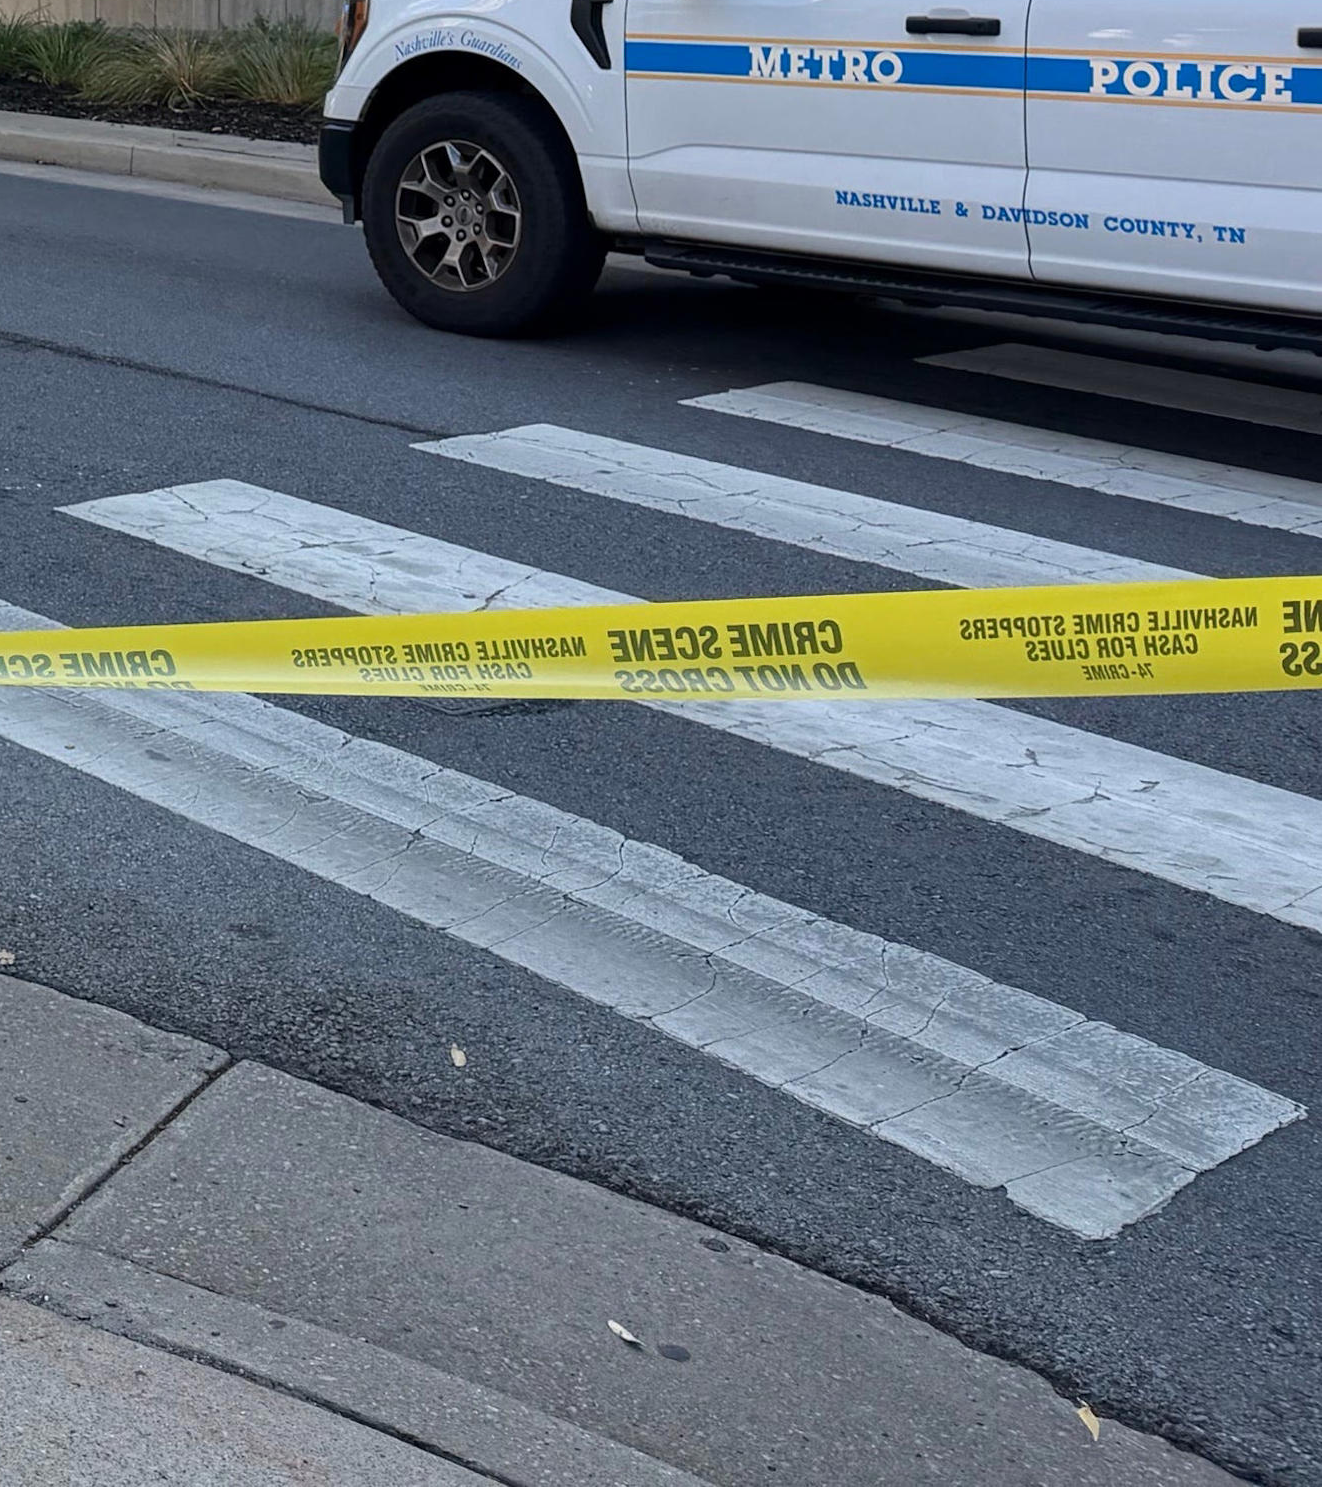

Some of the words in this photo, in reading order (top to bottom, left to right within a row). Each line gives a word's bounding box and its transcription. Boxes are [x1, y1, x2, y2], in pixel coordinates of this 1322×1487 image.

[395, 30, 455, 62] Nashville's
[460, 30, 524, 71] Guardians
[748, 45, 905, 85] METRO
[1089, 59, 1293, 103] POLICE
[835, 190, 942, 215] NASHVILLE
[955, 201, 969, 218] &
[982, 205, 1089, 230] DAVIDSON
[1104, 216, 1204, 244] COUNTY,
[1213, 226, 1246, 245] TN
